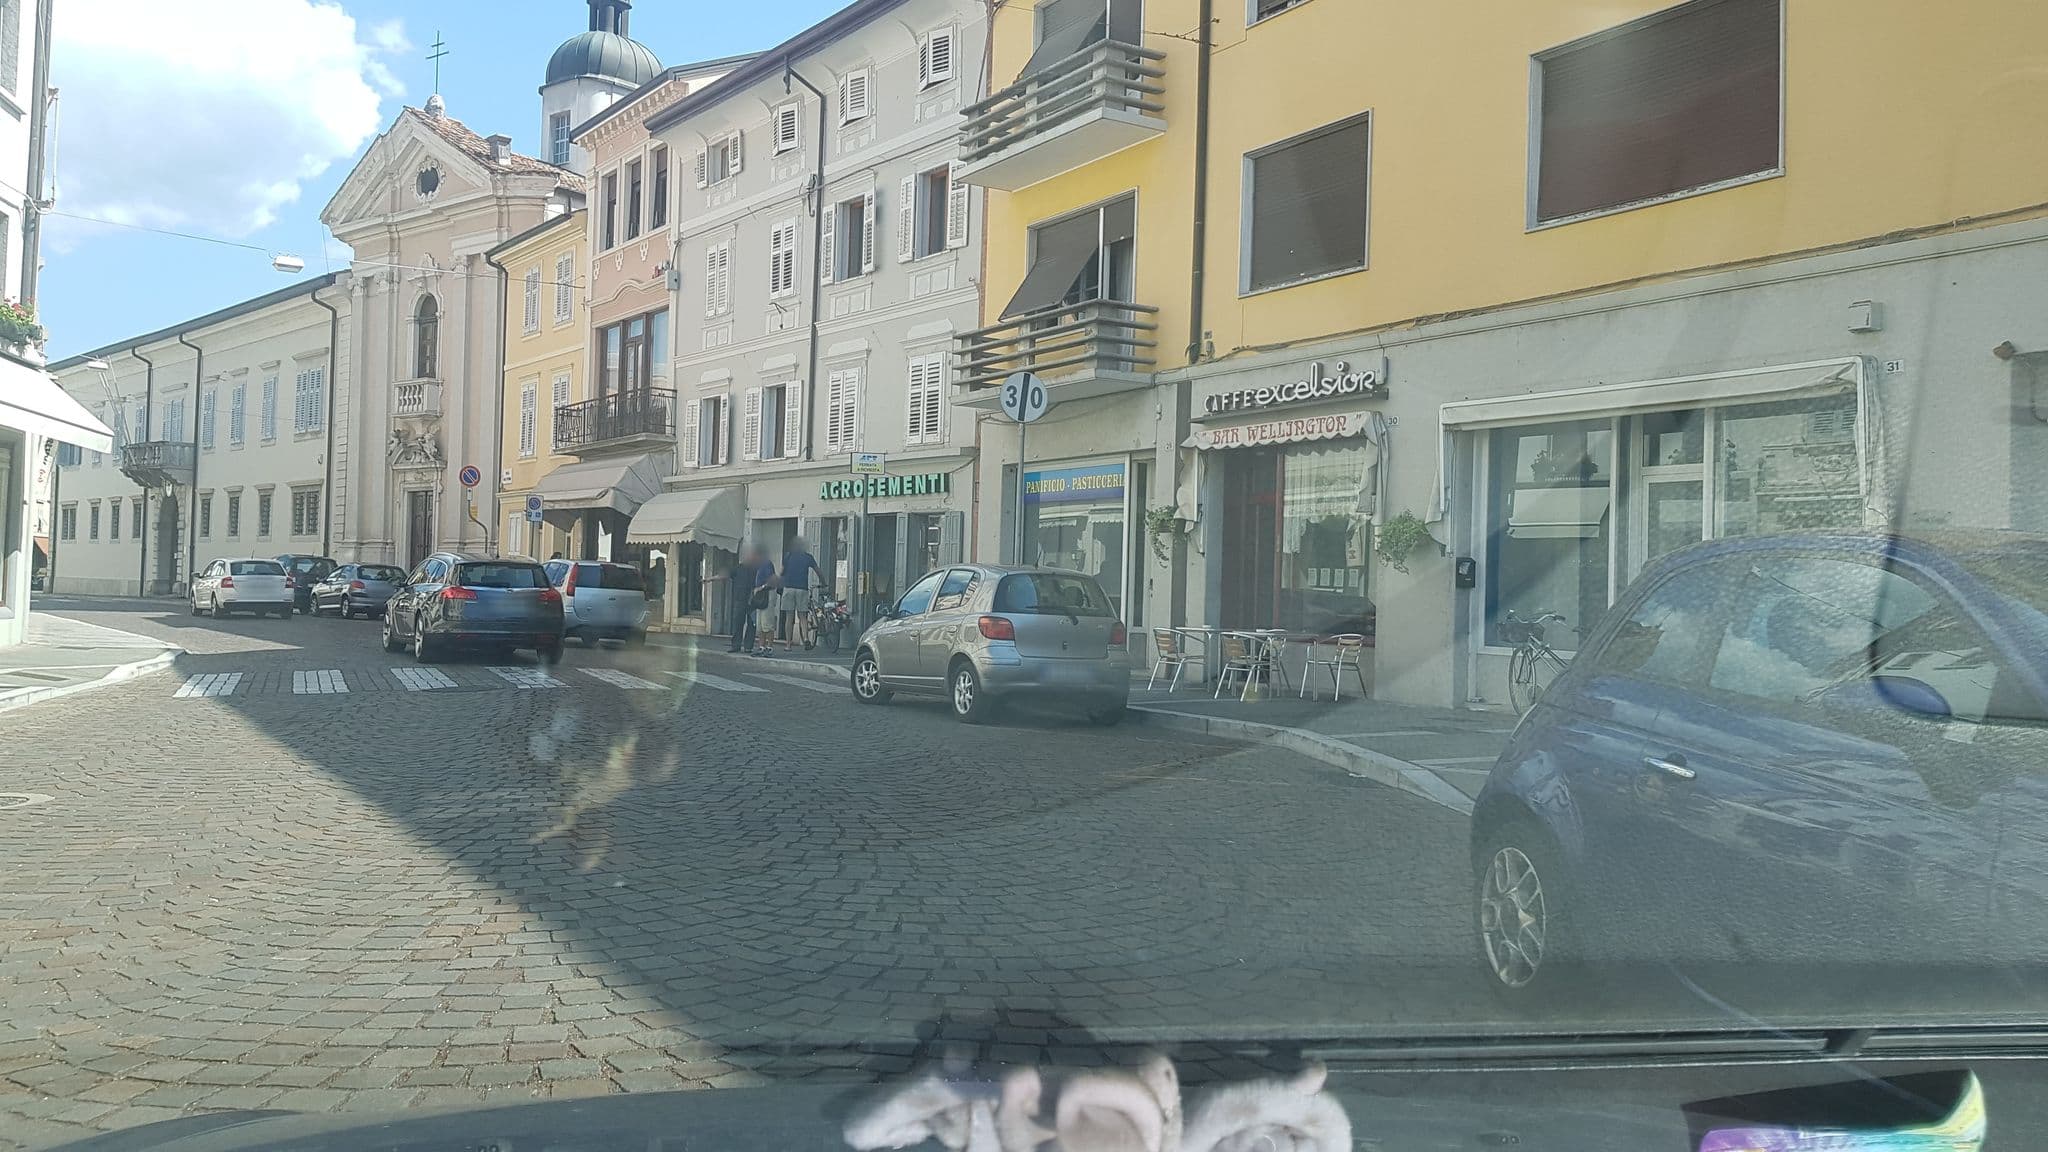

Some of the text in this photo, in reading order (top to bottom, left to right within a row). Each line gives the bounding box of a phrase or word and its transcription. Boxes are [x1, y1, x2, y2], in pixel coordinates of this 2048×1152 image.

[1887, 361, 1899, 372] 31
[1005, 385, 1043, 409] 30
[1388, 416, 1398, 425] 30
[819, 473, 945, 499] AGROSEMENTI
[1026, 478, 1065, 494] PANIFICIO
